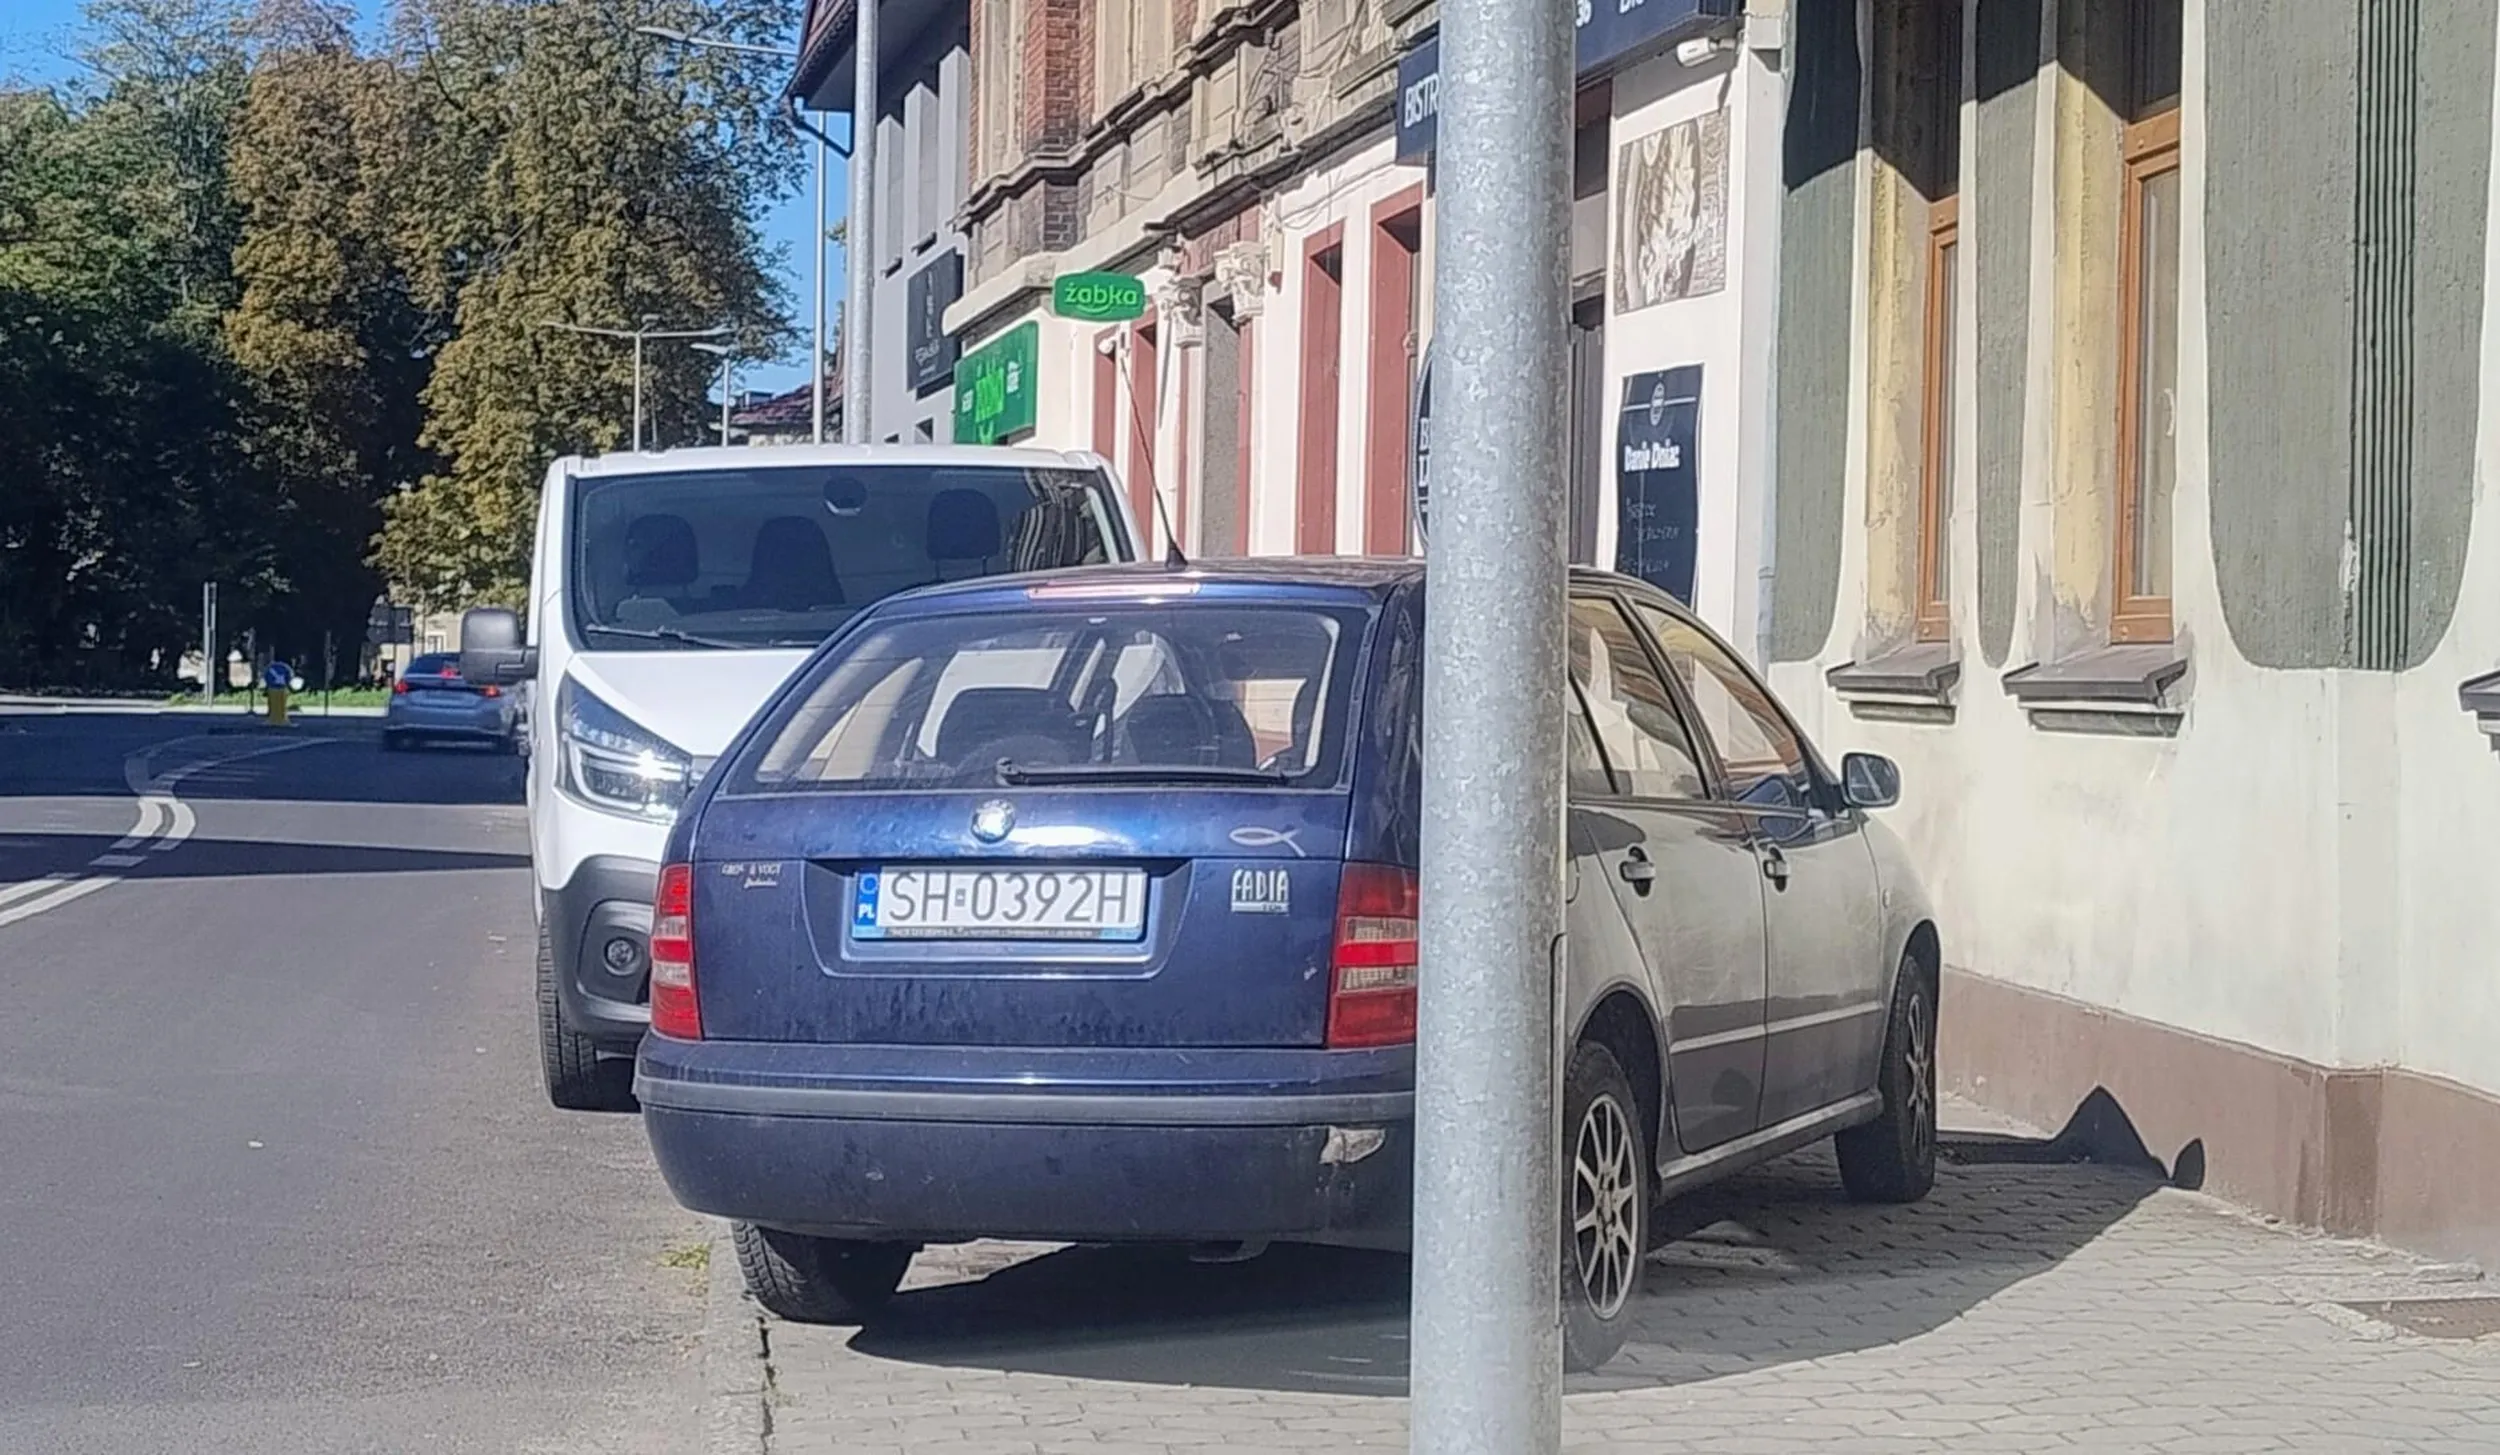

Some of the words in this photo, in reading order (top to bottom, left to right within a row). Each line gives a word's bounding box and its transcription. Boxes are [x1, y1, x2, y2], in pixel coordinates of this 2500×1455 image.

[1404, 73, 1439, 128] BISTR
[1064, 282, 1137, 308] żabka
[858, 903, 875, 919] PL
[889, 871, 950, 922] SH
[970, 871, 1128, 923] 0392H
